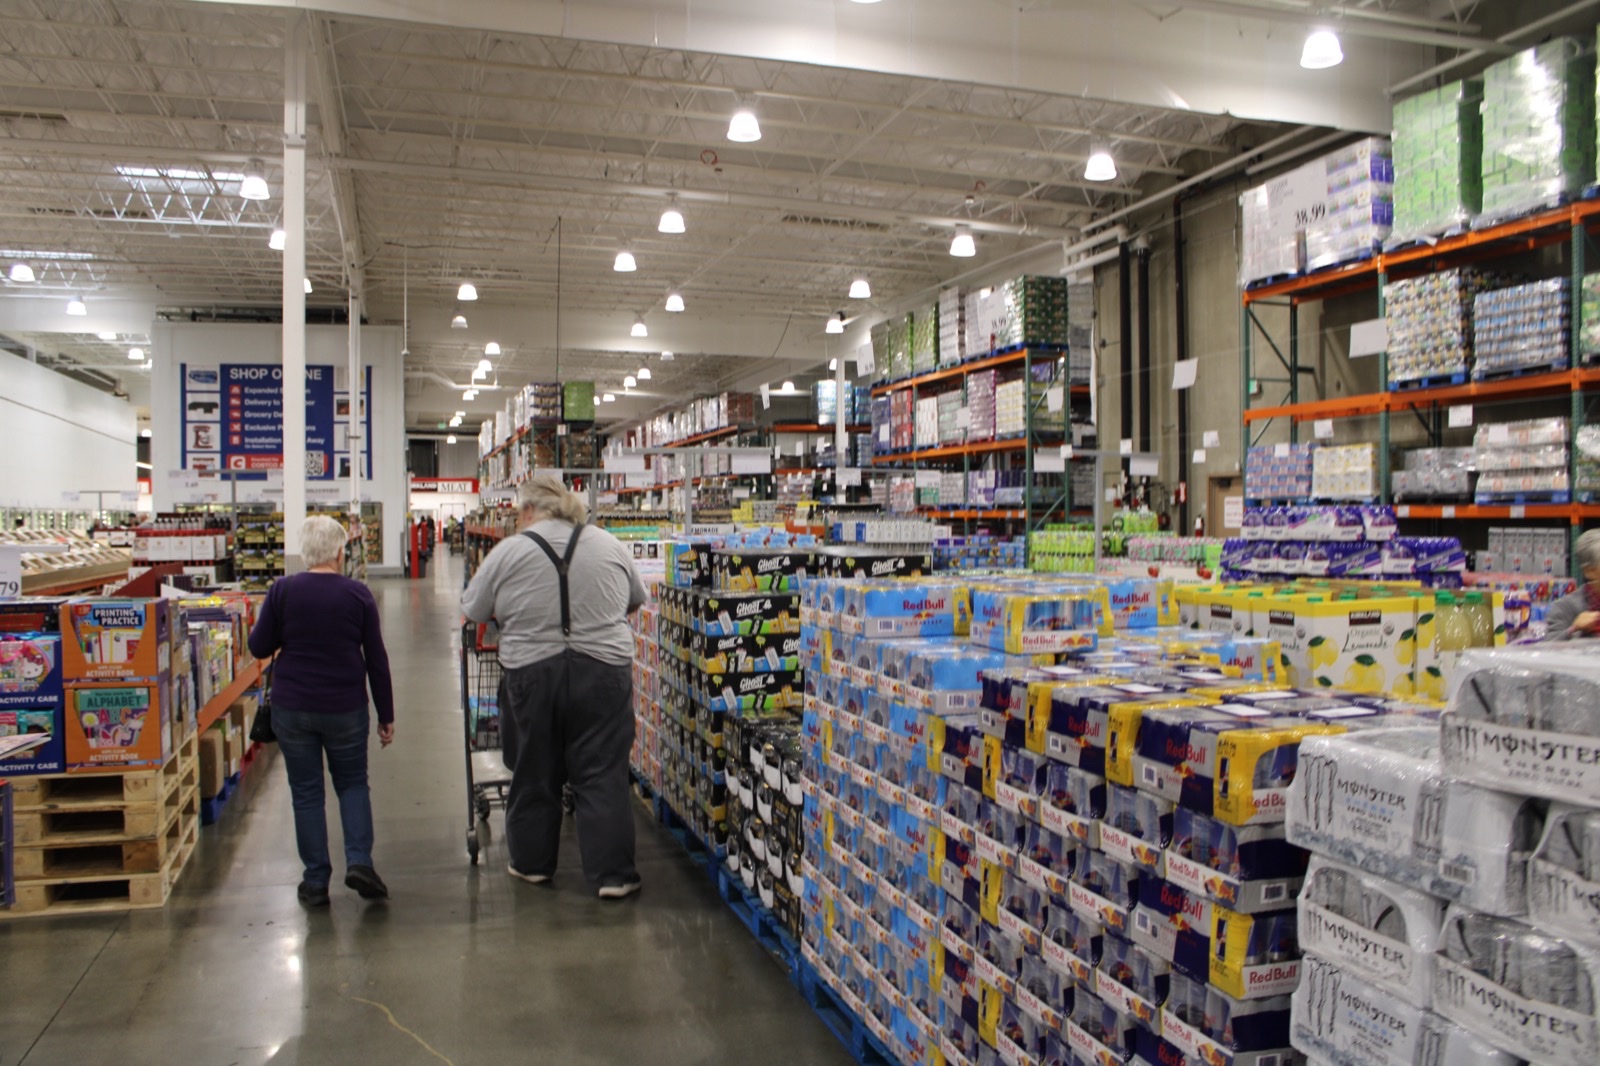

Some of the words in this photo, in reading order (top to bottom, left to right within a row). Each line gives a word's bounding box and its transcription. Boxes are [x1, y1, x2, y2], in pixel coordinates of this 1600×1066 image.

[230, 368, 268, 379] SHOP
[272, 368, 322, 380] ONE
[758, 557, 783, 573] GHOST
[872, 557, 899, 574] GHOST
[95, 608, 134, 617] PRINTING
[737, 599, 765, 617] GHOST
[102, 617, 139, 625] PRACTICE
[740, 674, 768, 692] GHOST
[37, 695, 58, 703] CASE
[87, 696, 141, 707] ALPHABET
[1337, 779, 1406, 811] MONSTER
[1324, 920, 1406, 970] MONSTER
[1249, 967, 1272, 984] Red
[1273, 964, 1297, 981] Bull
[1341, 990, 1407, 1037] MONSTER
[1470, 982, 1583, 1044] MONSTER
